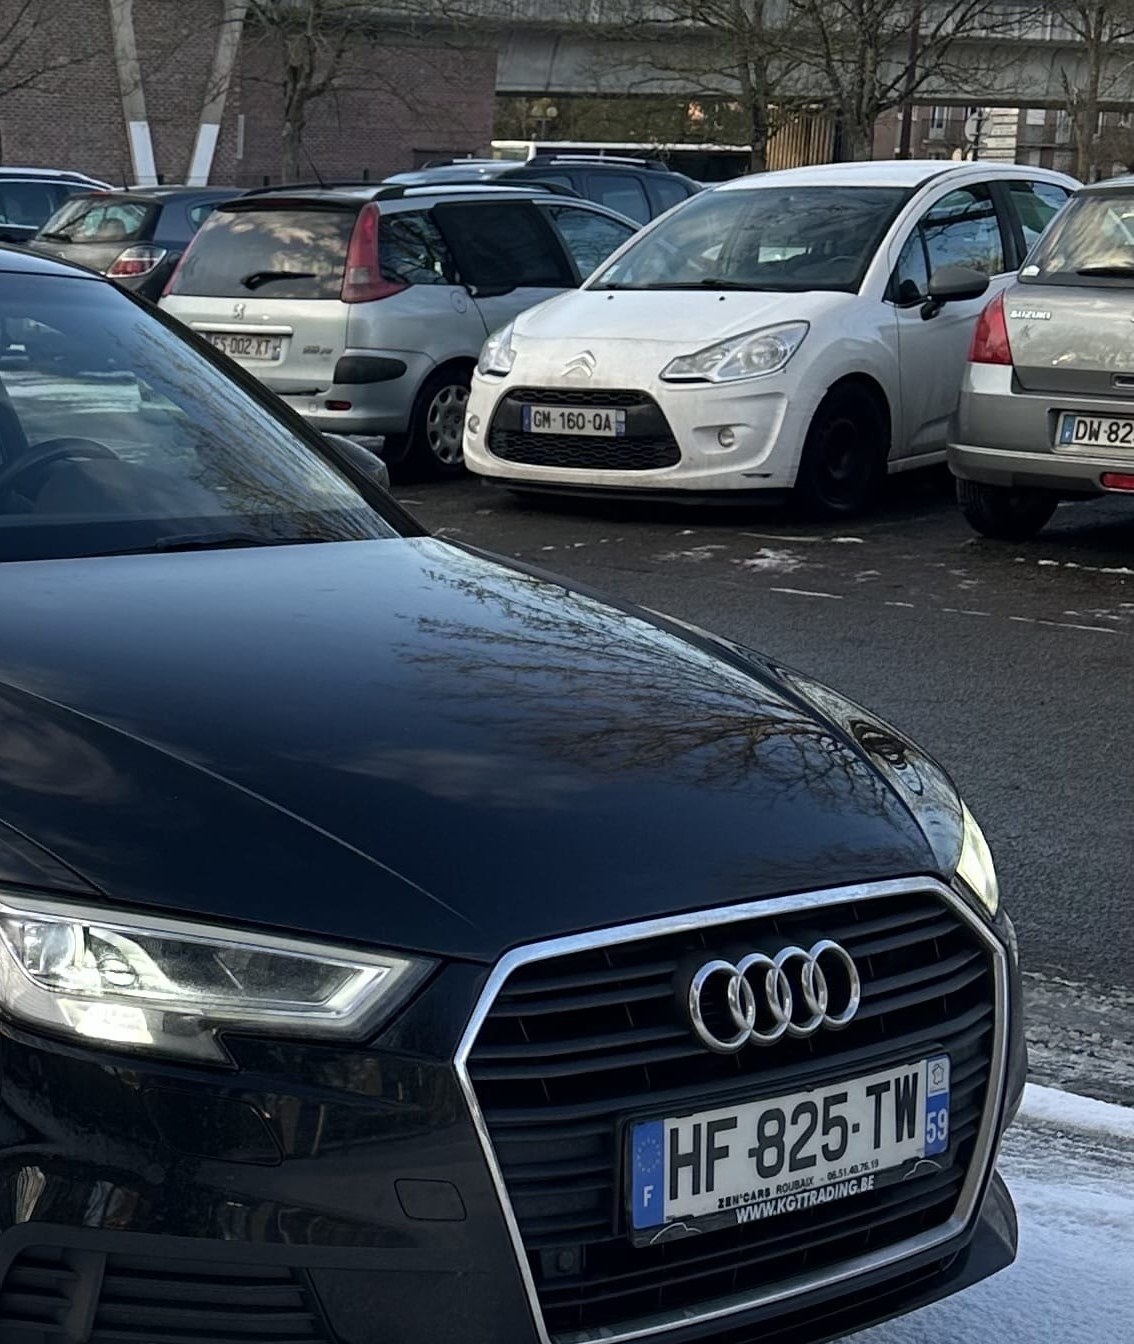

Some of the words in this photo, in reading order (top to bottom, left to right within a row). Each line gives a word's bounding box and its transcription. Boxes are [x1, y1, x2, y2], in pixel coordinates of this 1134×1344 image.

[533, 410, 612, 432] GM-160-QA
[1074, 419, 1134, 444] DW-82
[926, 1108, 948, 1144] 59
[643, 1185, 654, 1207] F
[776, 1175, 815, 1195] ROUBAIX
[735, 1174, 875, 1224] WWW.KGTTRADING.BE
